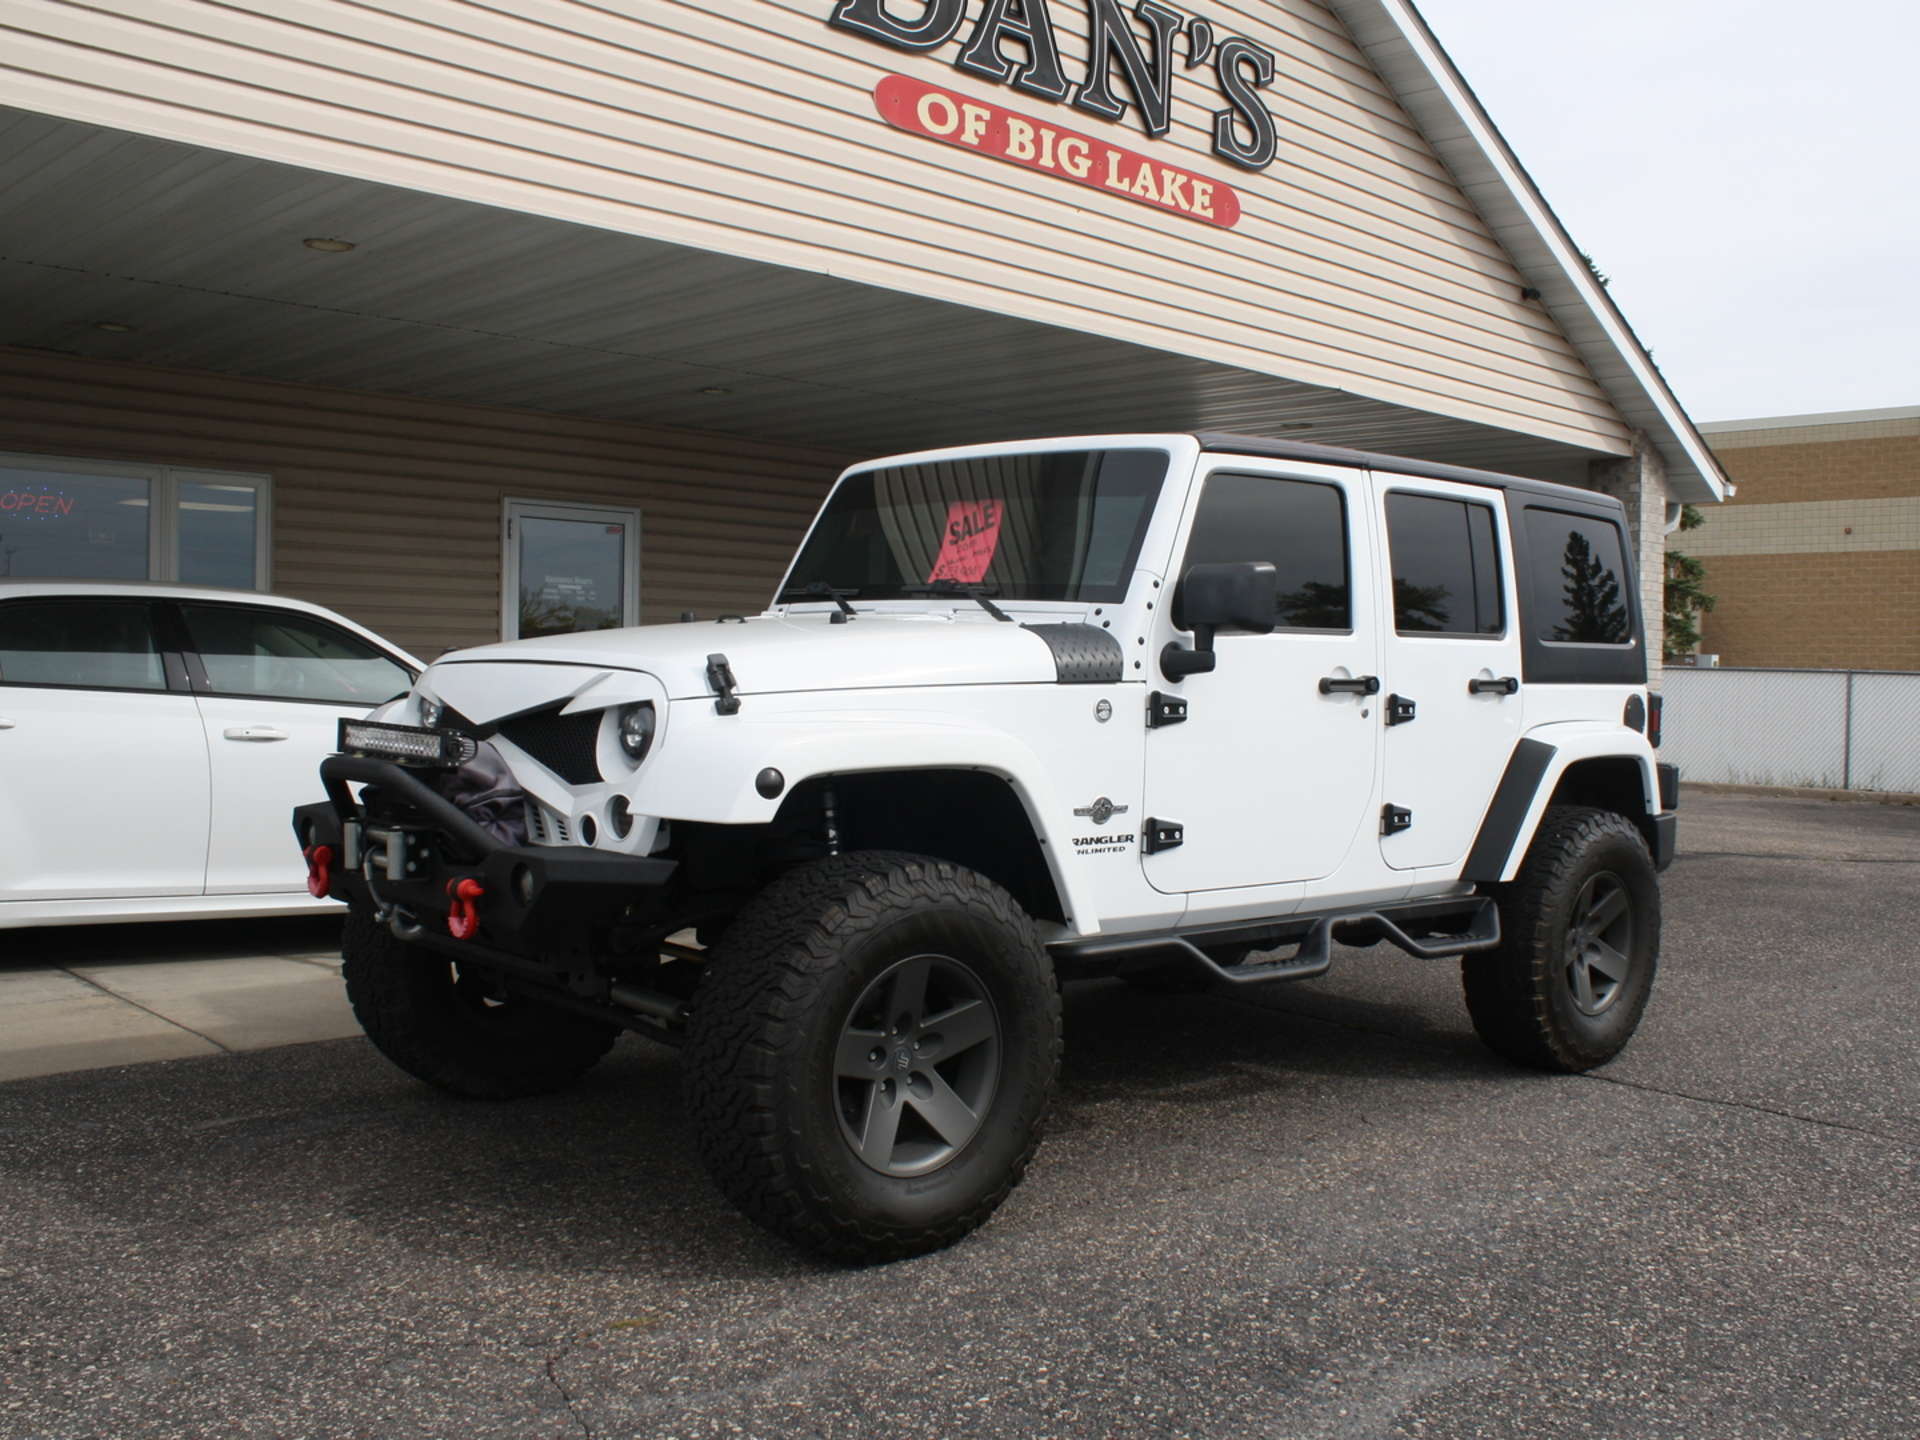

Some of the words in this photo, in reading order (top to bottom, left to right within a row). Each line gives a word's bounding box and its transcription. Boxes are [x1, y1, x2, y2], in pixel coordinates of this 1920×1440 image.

[916, 92, 991, 146] OF
[1005, 116, 1092, 179] BIG
[1104, 149, 1214, 219] LAKE
[0, 493, 74, 515] OPEN
[949, 504, 995, 545] SALE
